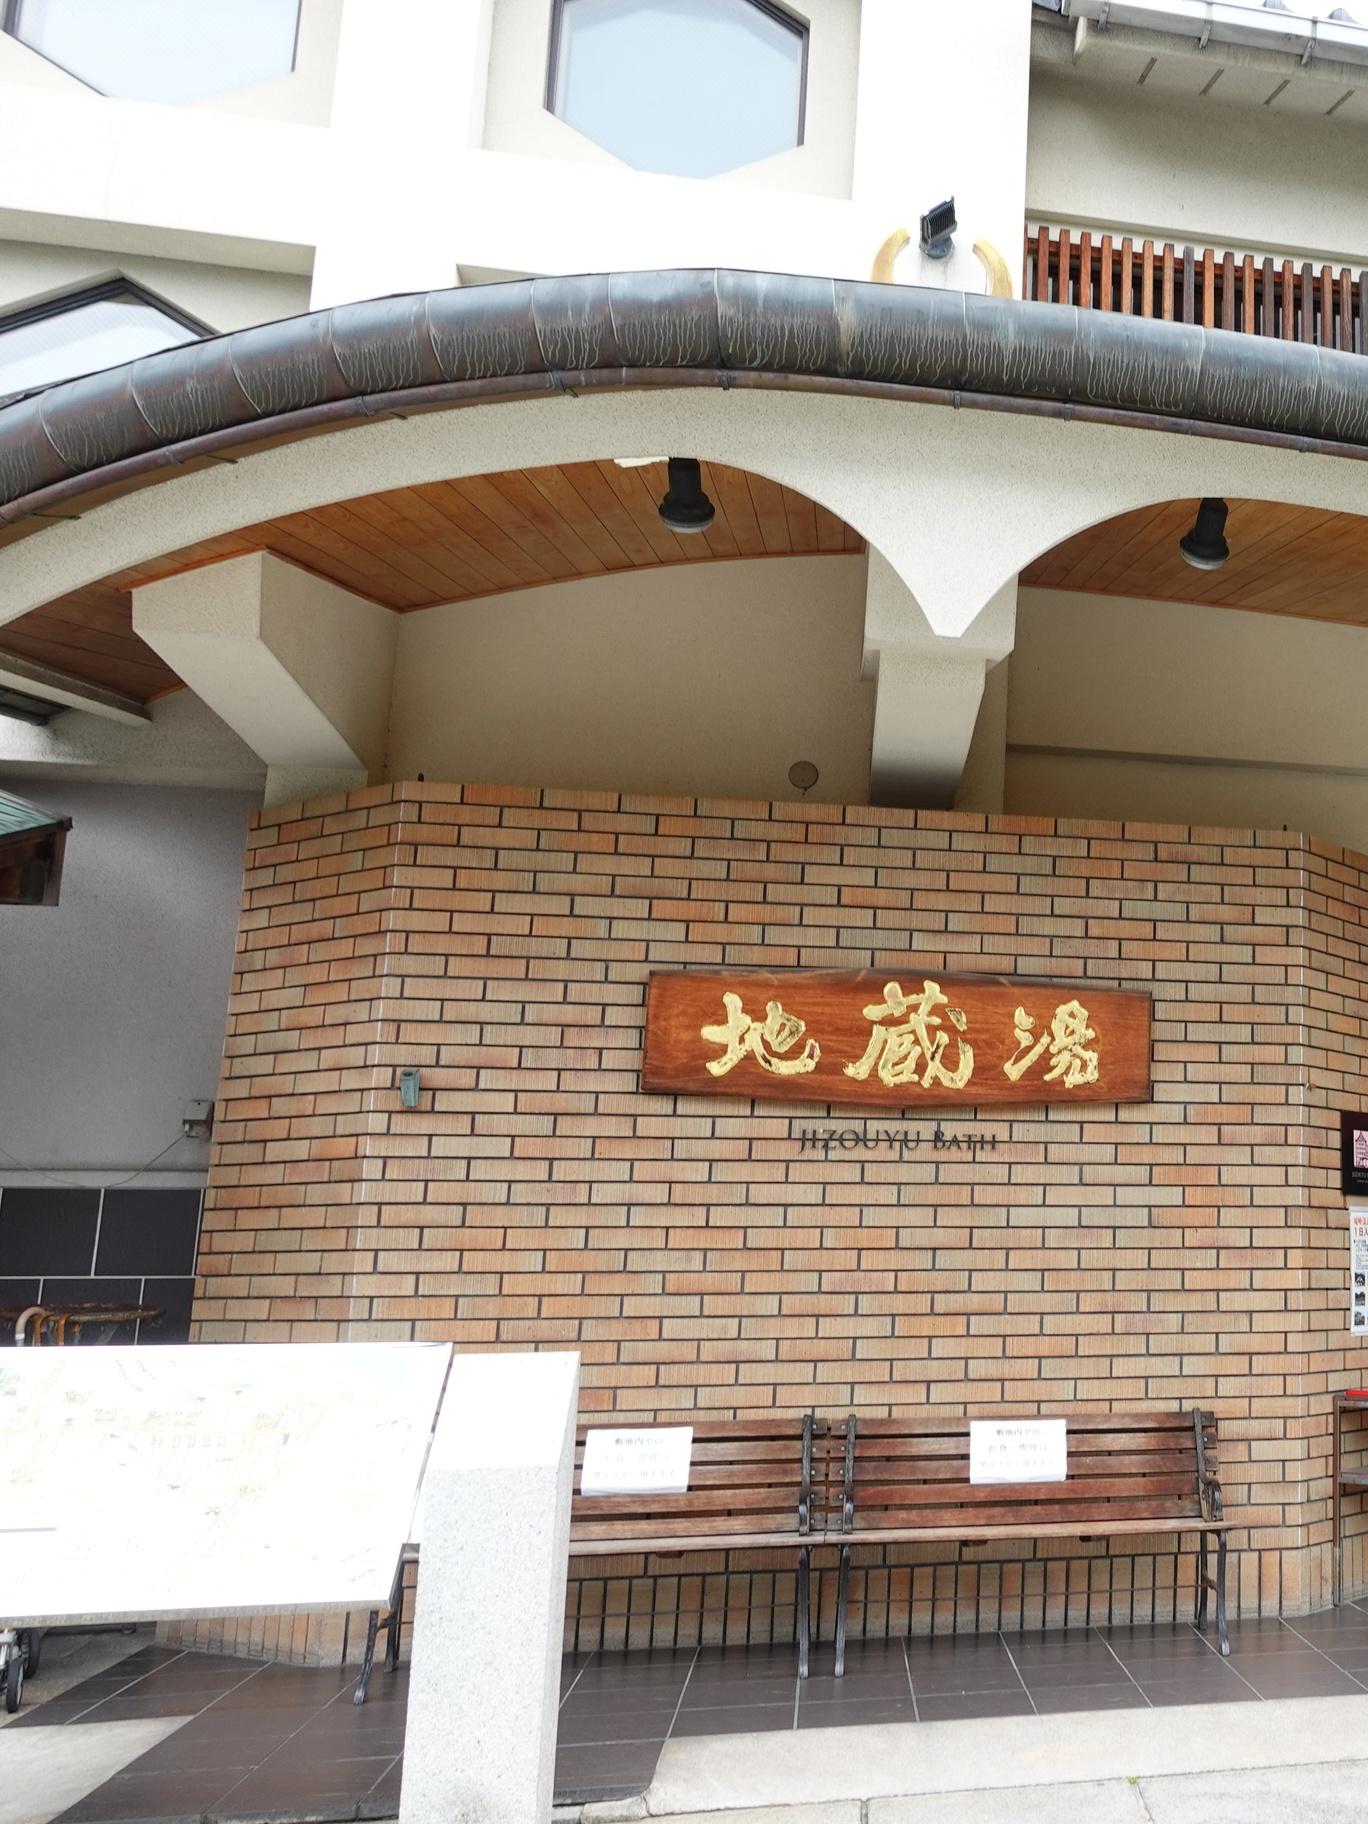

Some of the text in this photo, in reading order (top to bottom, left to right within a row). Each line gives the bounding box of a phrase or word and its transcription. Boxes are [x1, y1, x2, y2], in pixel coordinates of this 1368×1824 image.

[701, 980, 1099, 1088] 地蔵湯
[798, 1128, 921, 1153] JIZOUYU
